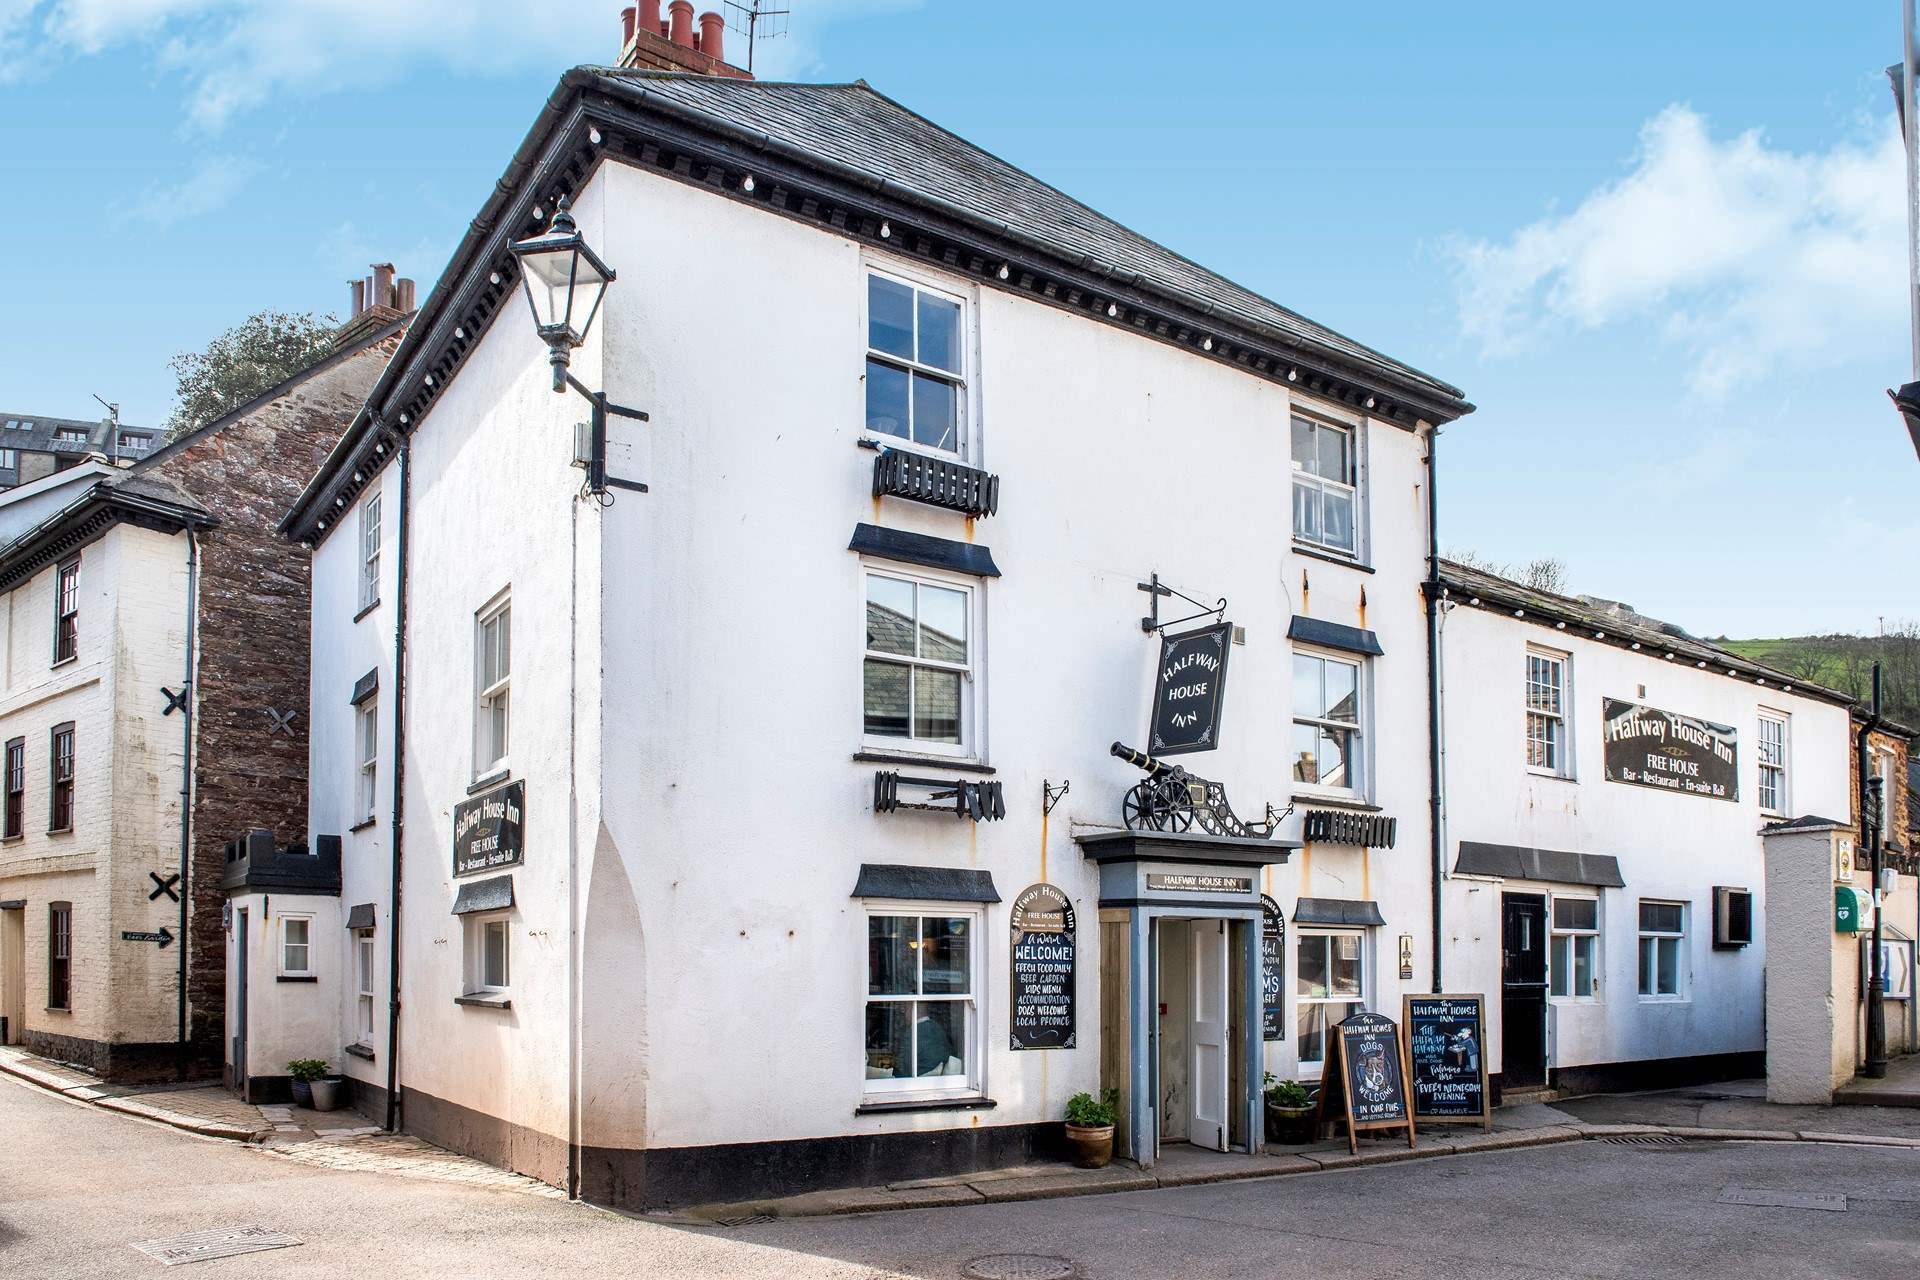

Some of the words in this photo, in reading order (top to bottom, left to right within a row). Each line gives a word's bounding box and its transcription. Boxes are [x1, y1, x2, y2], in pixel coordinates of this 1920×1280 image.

[1163, 653, 1220, 682] HALFWAY
[1169, 682, 1207, 700] HOUSE
[1171, 710, 1197, 728] INN
[1611, 712, 1667, 744] Halfway
[1670, 717, 1710, 750] House
[1713, 735, 1733, 765] Inn
[1647, 753, 1667, 771] FREE
[1669, 758, 1699, 777] HOUSE
[1623, 767, 1636, 780] Bar
[1643, 771, 1680, 788] Restaurant
[1685, 779, 1711, 794] En-suite
[456, 807, 481, 842] Halfway
[483, 798, 505, 820] House
[506, 798, 520, 825] Inn
[471, 840, 481, 854] FREE
[482, 835, 499, 852] HOUSE
[1164, 875, 1197, 885] HALFWAY
[1198, 876, 1222, 886] HOUSE
[1223, 878, 1237, 887] INN
[1012, 890, 1038, 926] Halfway
[1042, 886, 1068, 909] House
[1066, 909, 1075, 929] Inn
[1041, 912, 1061, 920] HOUSE
[1015, 945, 1073, 961] WELCOME!
[1015, 962, 1036, 973] FRESH
[1037, 963, 1053, 973] FOOD
[1054, 963, 1072, 973] DAILY
[1020, 973, 1037, 983] BEER
[1040, 974, 1066, 984] GARDEN
[1025, 984, 1041, 995] KIDS
[1042, 984, 1062, 994] MENU
[1017, 994, 1071, 1005] ACCOMMODATION
[1018, 1005, 1035, 1016] DOGS
[1037, 1005, 1067, 1015] WELCOME
[1413, 1006, 1447, 1015] HALFWAY
[1450, 1005, 1477, 1015] HOUSE
[1016, 1017, 1037, 1026] LOCAL
[1040, 1016, 1070, 1026] PRODUCE
[1362, 1015, 1375, 1024] The
[1440, 1015, 1454, 1023] INN
[1343, 1025, 1370, 1035] HALFWAY
[1371, 1023, 1393, 1033] HOUSE
[1420, 1024, 1436, 1036] THE
[1364, 1033, 1376, 1041] INN
[1360, 1041, 1383, 1053] DOGS
[1359, 1085, 1394, 1102] WELCOME
[1419, 1082, 1442, 1093] EVERY
[1443, 1083, 1481, 1093] WEDNESDAY
[1433, 1092, 1466, 1101] EVENING
[1359, 1105, 1368, 1114] IN
[1370, 1103, 1384, 1113] OUR
[1385, 1102, 1399, 1112] PUB
